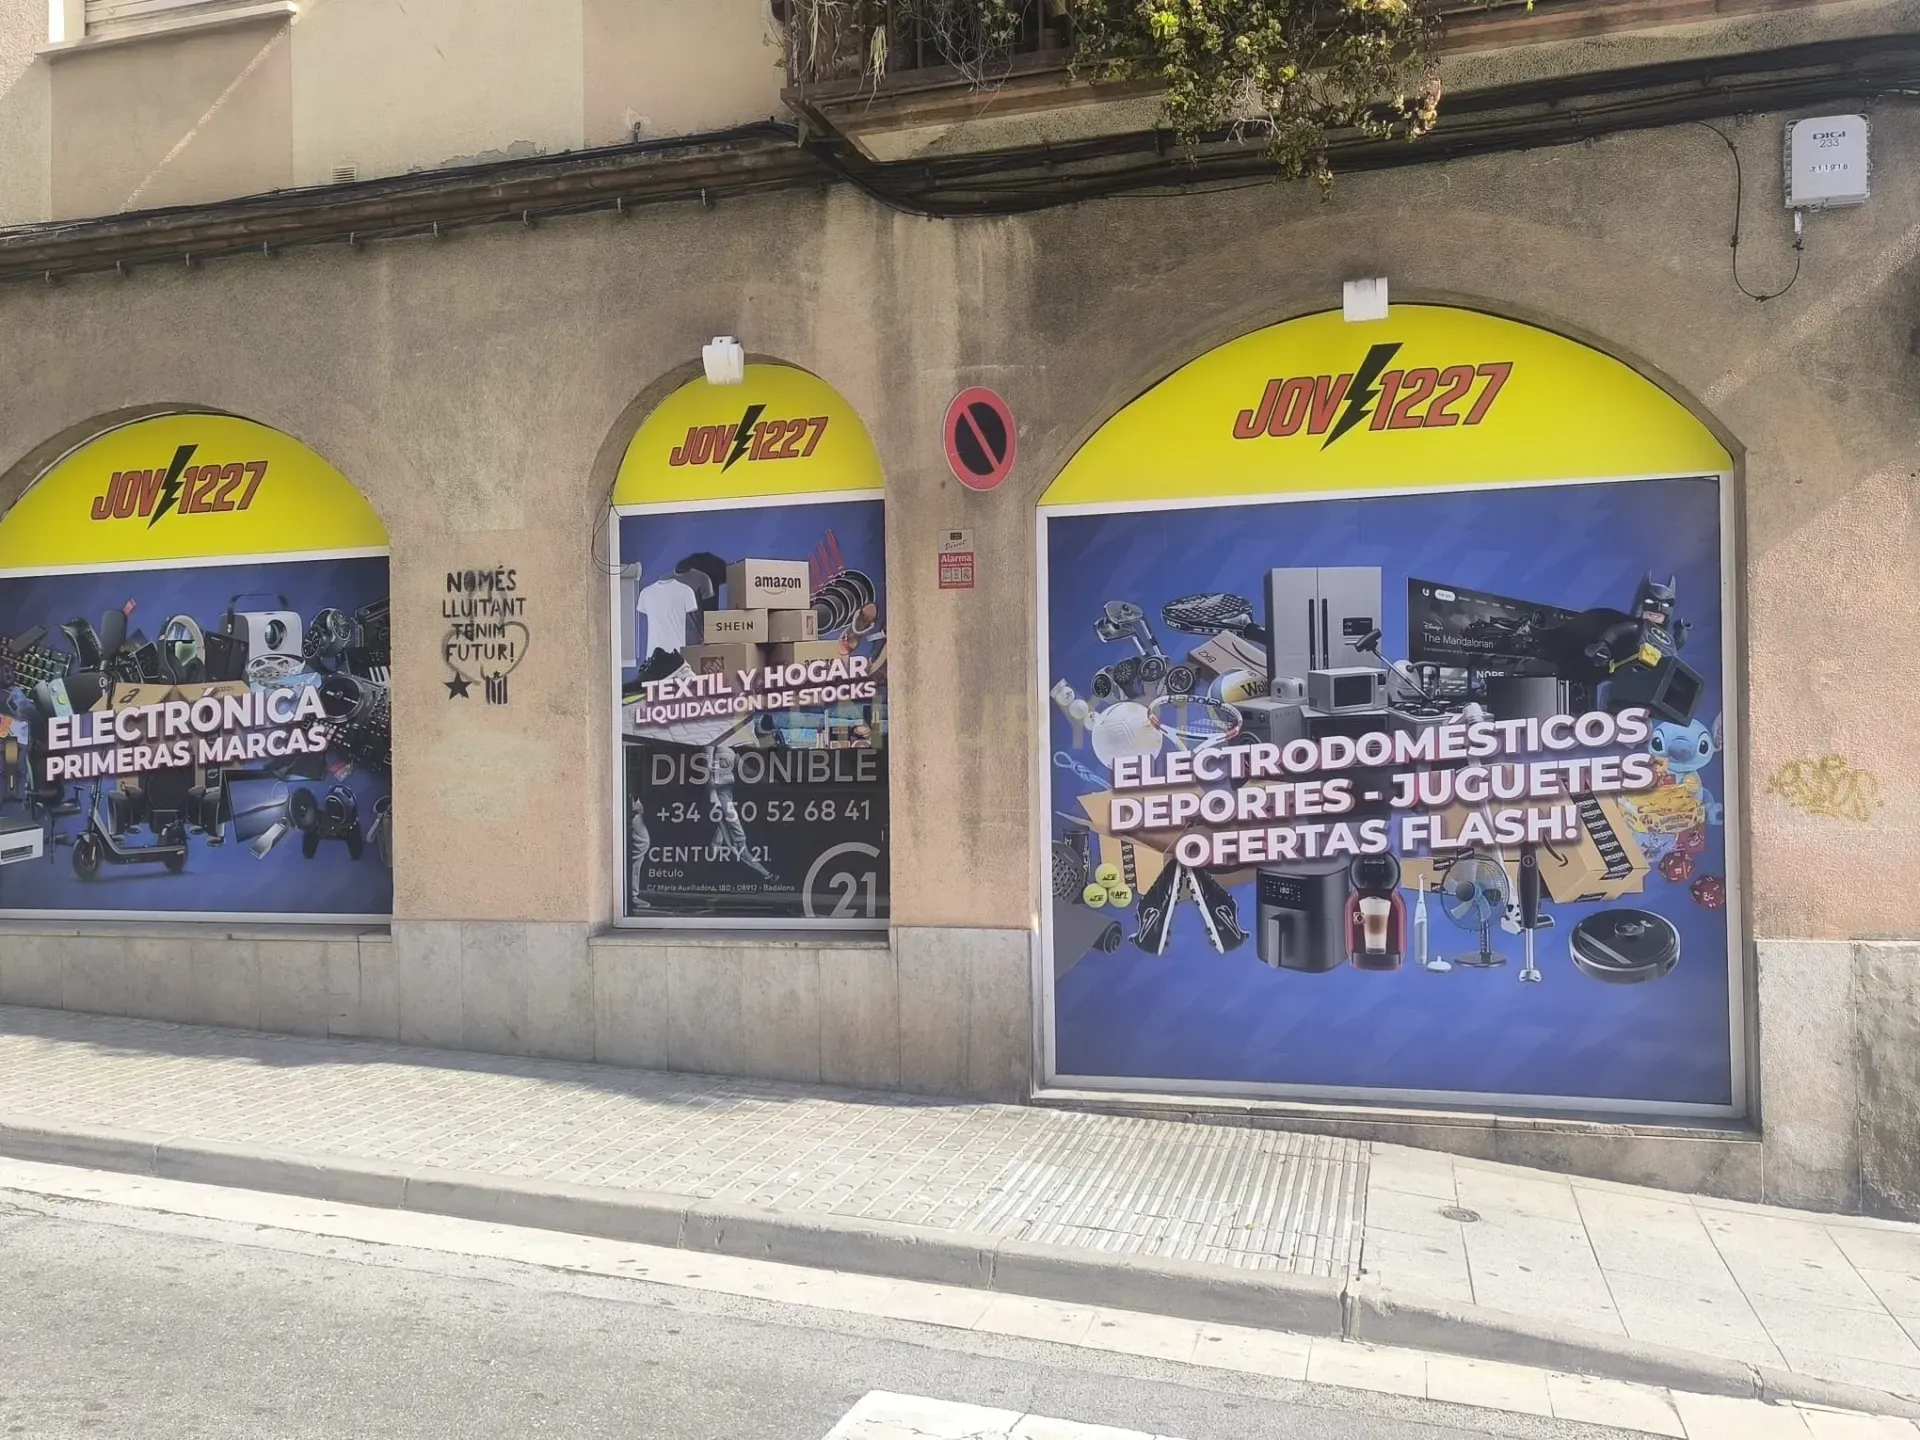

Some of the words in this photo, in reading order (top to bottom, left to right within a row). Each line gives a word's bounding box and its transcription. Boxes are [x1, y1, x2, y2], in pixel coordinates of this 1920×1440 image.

[1812, 131, 1846, 140] DIGI
[1820, 138, 1840, 148] 233
[941, 554, 972, 563] Alarma
[446, 565, 517, 593] NOMÉS
[754, 574, 802, 589] amazon
[442, 597, 527, 619] LLUITANT
[715, 621, 754, 632] SHEIN
[1423, 632, 1441, 644] The
[1442, 634, 1494, 649] Mandalorian
[446, 642, 514, 662] FUTUR!
[641, 671, 732, 702] TEXTIL
[737, 668, 757, 691] Y
[764, 656, 868, 689] HOGAR
[635, 692, 763, 725] LIQUIDACIÓN
[767, 691, 795, 709] DE
[798, 681, 876, 706] STOCKS
[48, 685, 327, 751] ELECTRÓNICA
[46, 740, 191, 781] PRIMERAS
[199, 726, 328, 765] MARCAS
[1112, 706, 1649, 789] ELECTRODOMÉSTICOS
[651, 748, 877, 786] DISPONIBLE
[1109, 778, 1354, 832] DEPORTES
[1390, 753, 1655, 808] JUGUETES
[656, 802, 701, 823] +34
[766, 801, 795, 822] 52
[804, 800, 836, 821] 68
[844, 799, 870, 821] 41
[1175, 819, 1388, 867] OFERTAS
[1402, 804, 1580, 851] FLASH!
[648, 846, 743, 863] CENTURY
[648, 868, 684, 878] Bétulo
[678, 884, 718, 892] Auxiliadora,
[763, 884, 796, 892] Badalona
